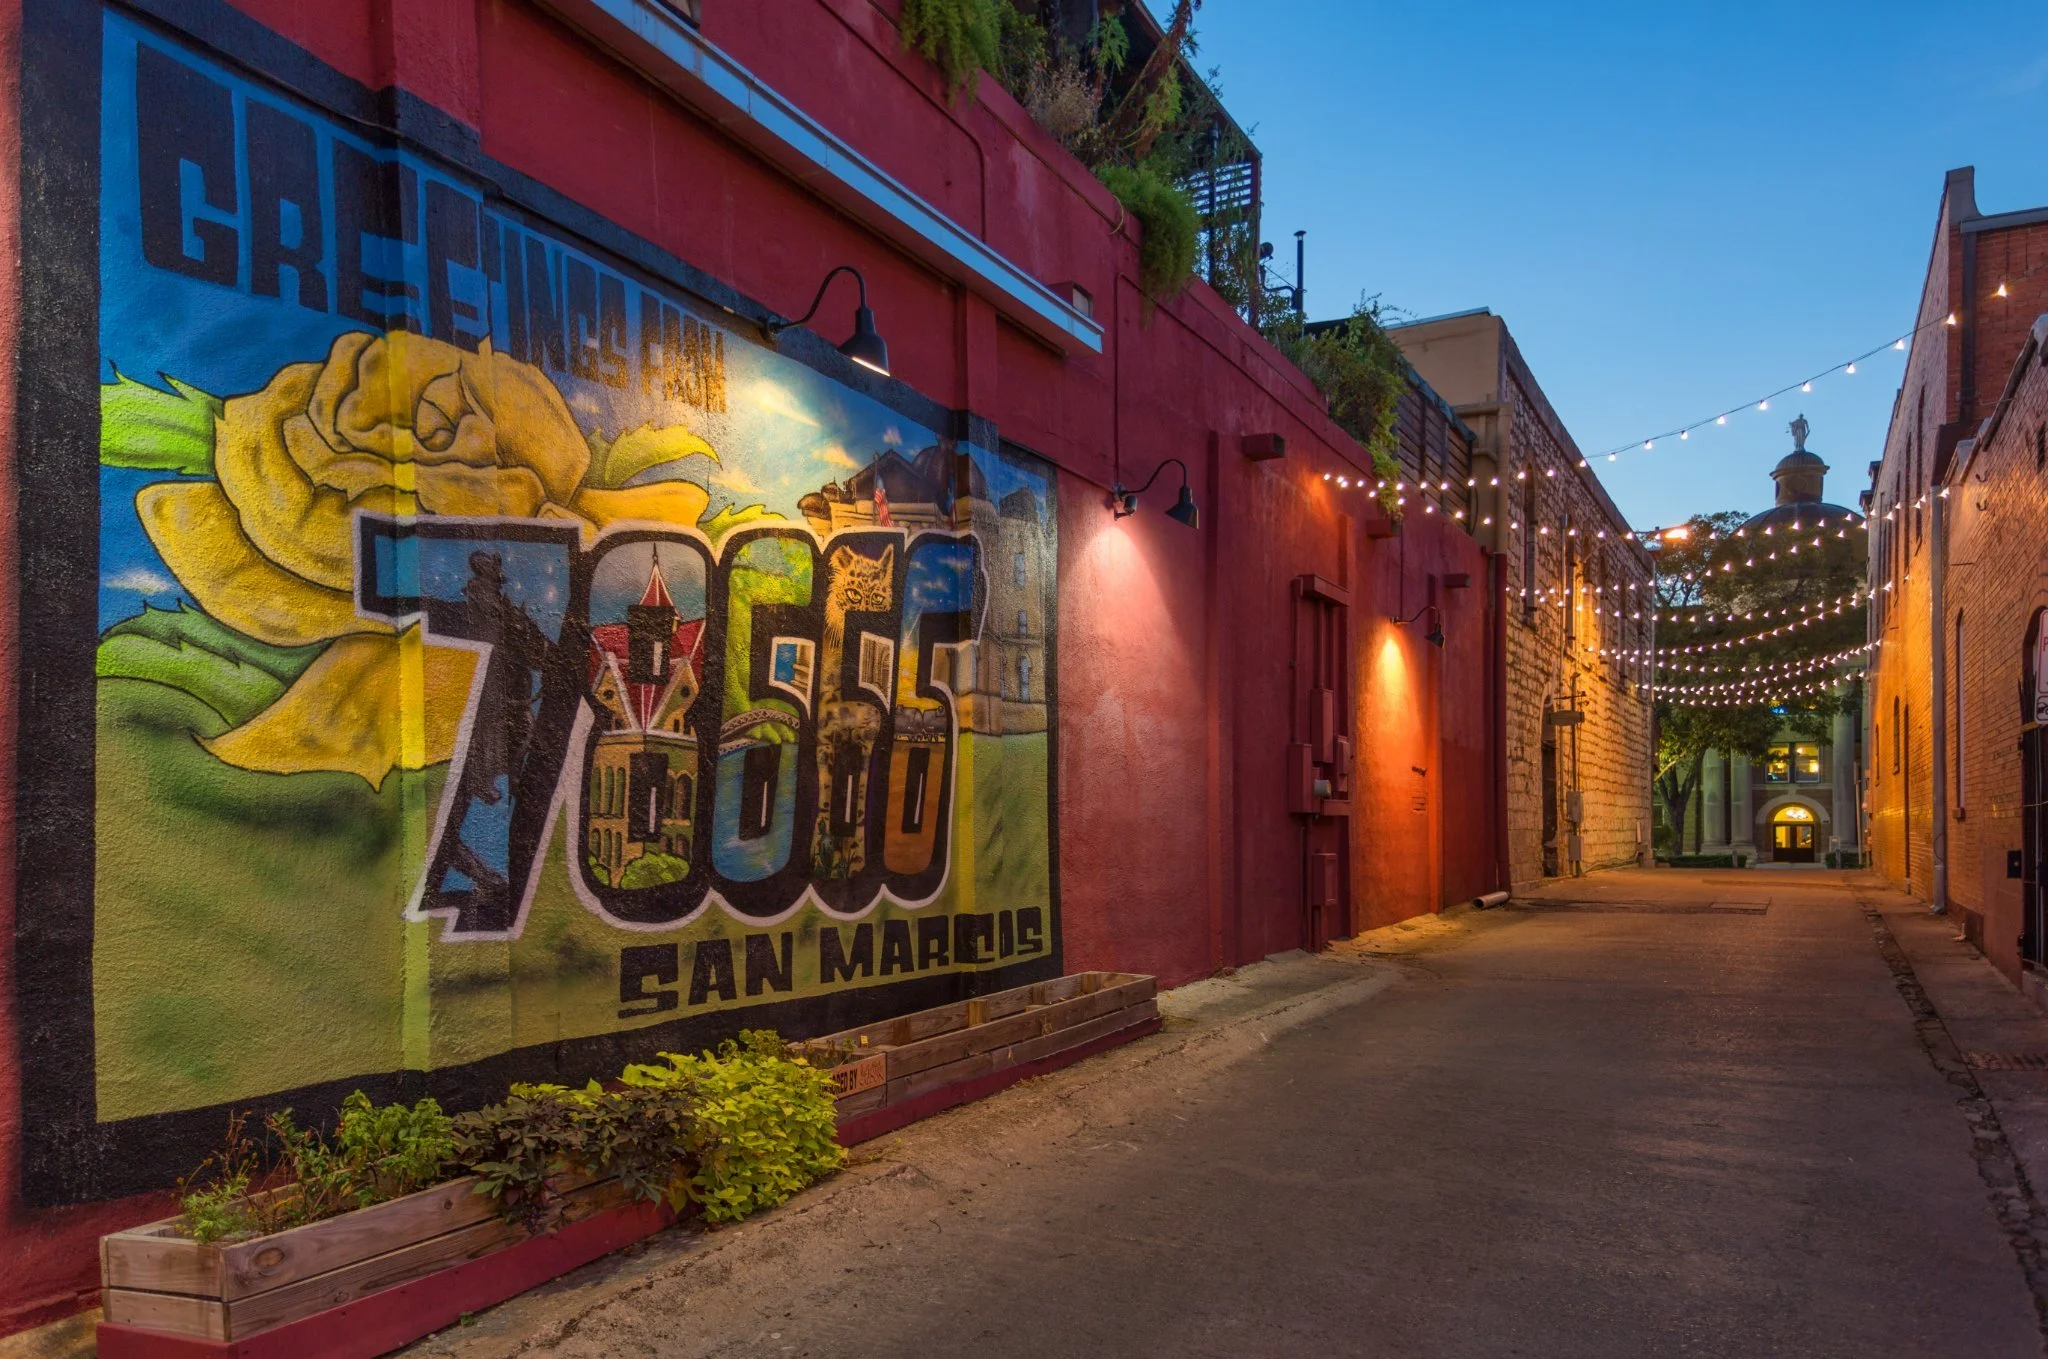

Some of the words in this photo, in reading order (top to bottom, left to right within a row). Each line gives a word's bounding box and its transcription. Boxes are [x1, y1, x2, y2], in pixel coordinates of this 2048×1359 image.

[136, 40, 628, 390] GREETINGS
[641, 290, 727, 413] FROM
[352, 508, 990, 943] 78666
[618, 932, 793, 1019] SAN
[820, 906, 1043, 984] MARCOS
